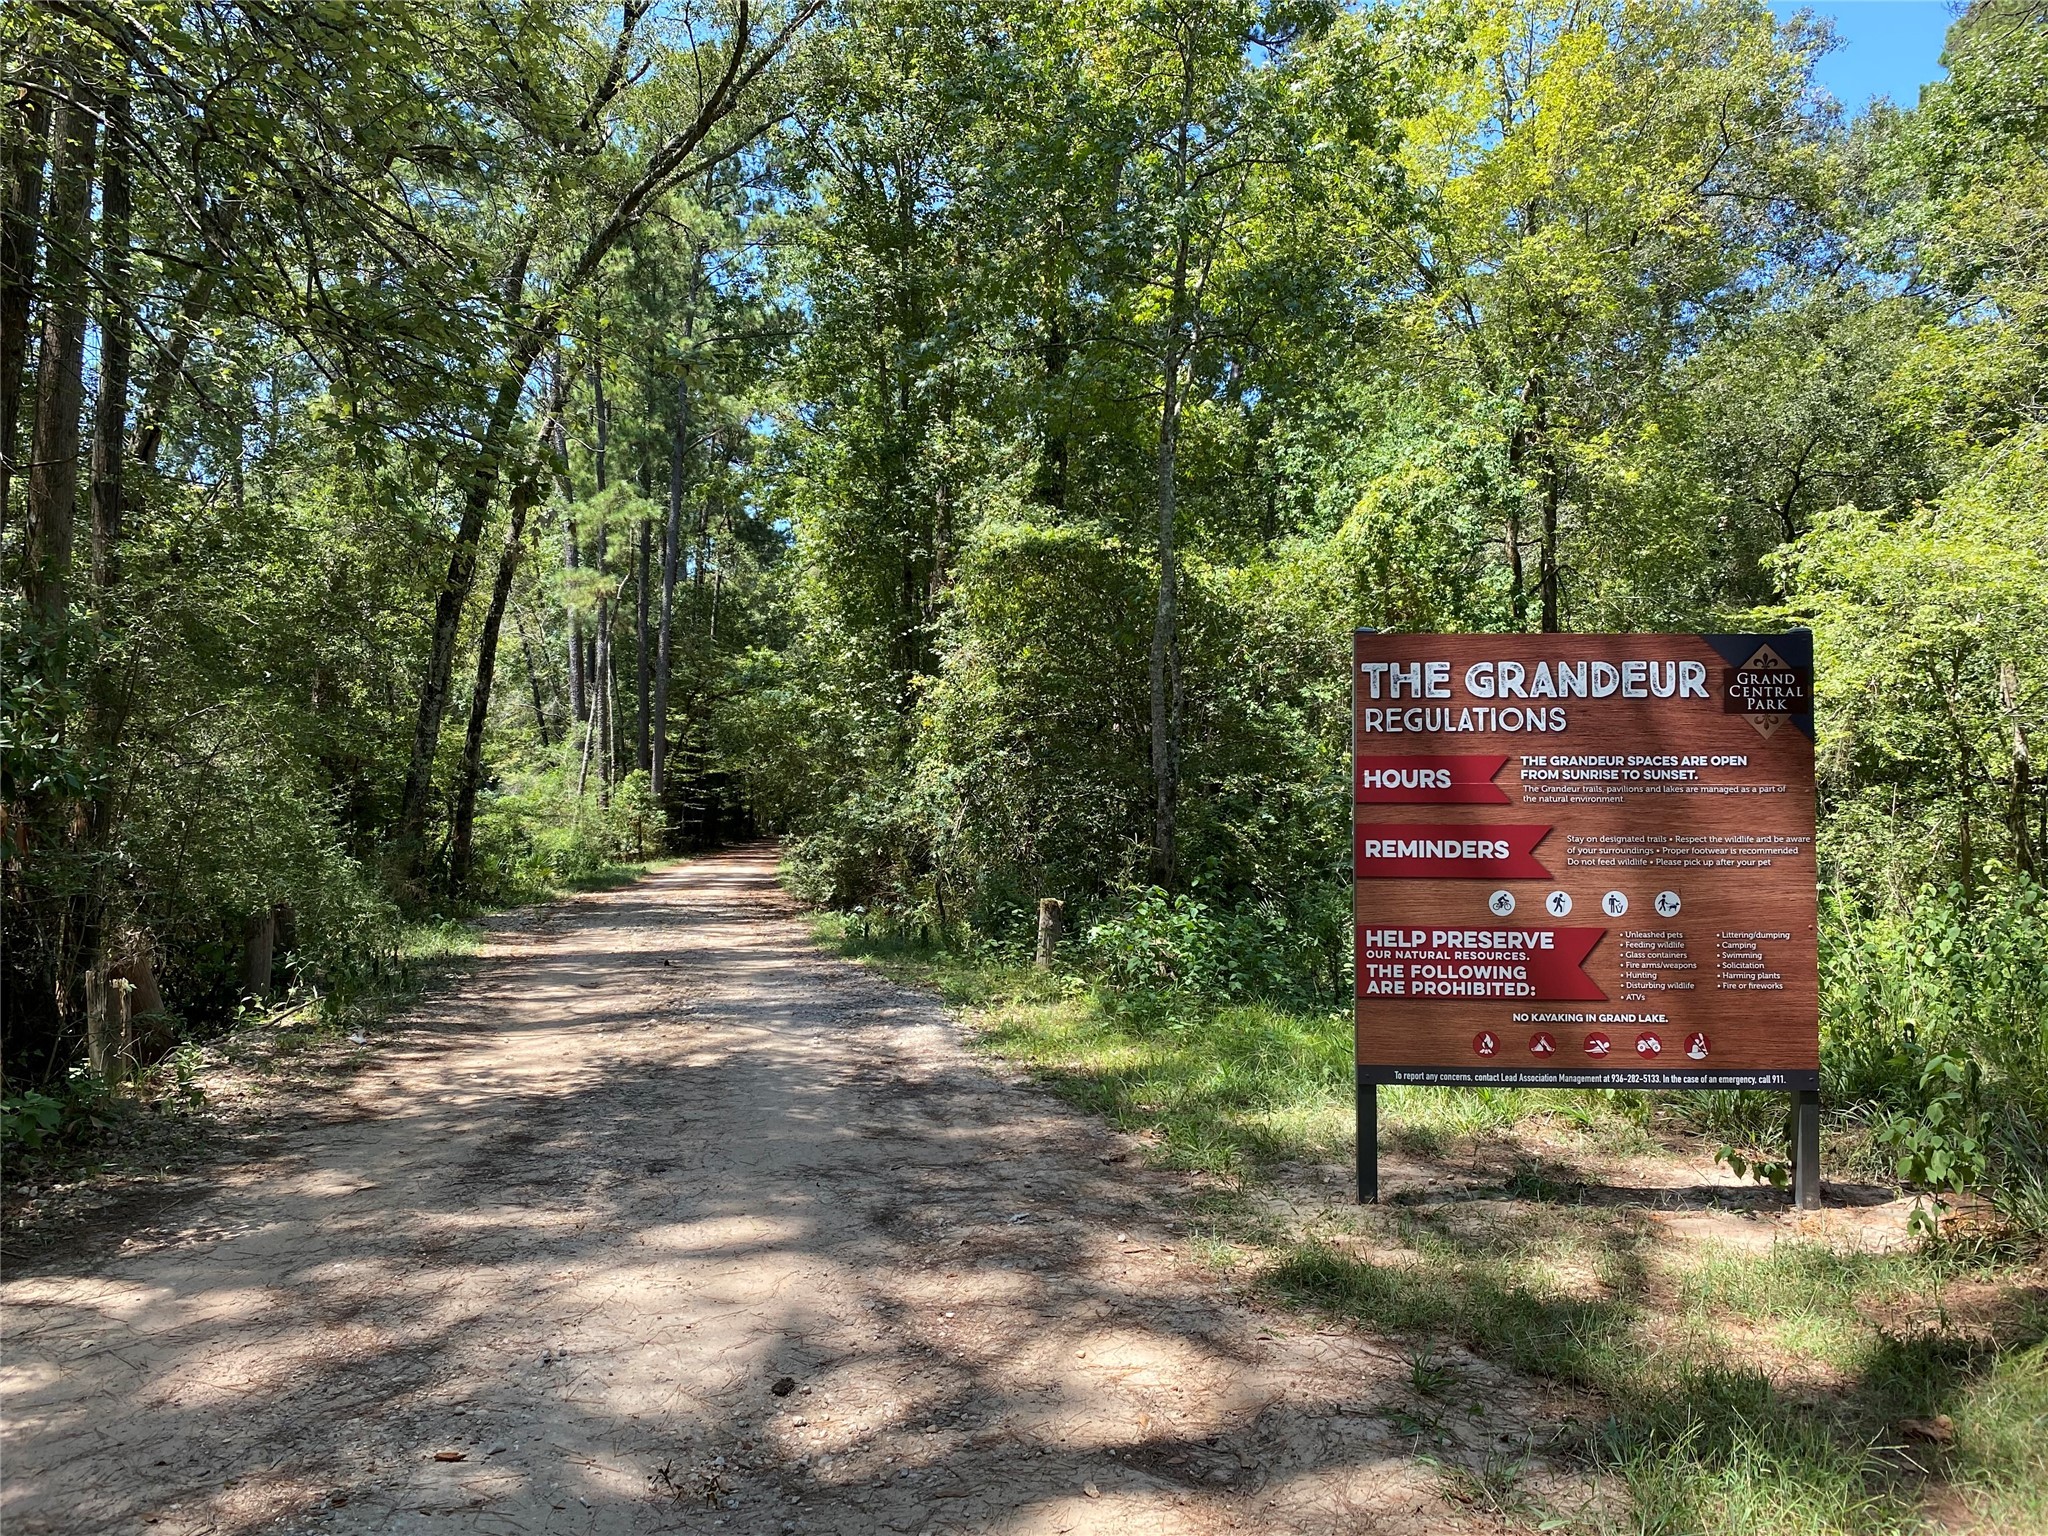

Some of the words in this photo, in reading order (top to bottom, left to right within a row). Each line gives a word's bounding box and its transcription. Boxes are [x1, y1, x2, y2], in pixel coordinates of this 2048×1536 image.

[1362, 662, 1450, 698] THE
[1465, 661, 1709, 697] GRANDEUR
[1736, 673, 1795, 685] GRAND
[1730, 684, 1803, 697] CENTRAL
[1747, 698, 1788, 710] PARK
[1366, 707, 1566, 732] REGULATIONS
[1520, 756, 1546, 765] THE
[1550, 756, 1624, 765] GRANDEUR
[1628, 756, 1678, 766] SPACES
[1681, 756, 1707, 765] ARE
[1711, 756, 1747, 765] OPEN
[1364, 769, 1451, 788] HOURS
[1521, 770, 1558, 779] FROM
[1562, 770, 1618, 779] SUNRISE
[1622, 770, 1640, 779] TO
[1643, 770, 1698, 779] SUNSET.
[1607, 785, 1643, 795] pavilions
[1646, 785, 1661, 793] and
[1663, 785, 1685, 793] lakes
[1701, 786, 1738, 795] managed
[1759, 784, 1775, 794] part
[1567, 835, 1584, 844] Stay
[1600, 835, 1644, 844] designated
[1675, 836, 1707, 844] Respect
[1366, 840, 1509, 859] REMINDERS
[1599, 847, 1653, 855] surroundings
[1662, 847, 1689, 855] Proper
[1684, 859, 1701, 867] pick
[1758, 859, 1771, 867] pet
[1367, 930, 1426, 948] HELP
[1432, 931, 1554, 949] PRESERVE
[1722, 932, 1790, 940] Littering/dumping
[1626, 941, 1655, 949] Feeding
[1722, 942, 1756, 950] Camping
[1366, 950, 1391, 958] OUR
[1396, 951, 1450, 959] NATURAL
[1455, 952, 1529, 960] RESOURCES.
[1722, 952, 1762, 960] Swimming
[1367, 964, 1405, 978] THE
[1411, 965, 1526, 980] FOLLOWING
[1626, 972, 1657, 980] Hunting
[1723, 972, 1755, 980] Harming
[1758, 972, 1780, 980] plants
[1367, 981, 1405, 994] ARE
[1412, 981, 1535, 996] PROHIBITED:
[1626, 982, 1665, 990] Disturbing
[1532, 1014, 1583, 1022] KAYAKING
[1586, 1014, 1596, 1022] IN
[1599, 1014, 1636, 1022] GRAND
[1639, 1014, 1668, 1022] LAKE.
[1395, 1071, 1402, 1079] To
[1404, 1072, 1424, 1081] report
[1426, 1074, 1438, 1082] any
[1475, 1073, 1499, 1081] contact
[1501, 1073, 1517, 1081] Lead
[1519, 1073, 1557, 1082] Association
[1559, 1074, 1600, 1084] Management
[1663, 1075, 1669, 1083] In
[1671, 1075, 1681, 1083] the
[1701, 1075, 1707, 1083] of
[1759, 1075, 1771, 1083] call
[1772, 1075, 1786, 1083] 911.
